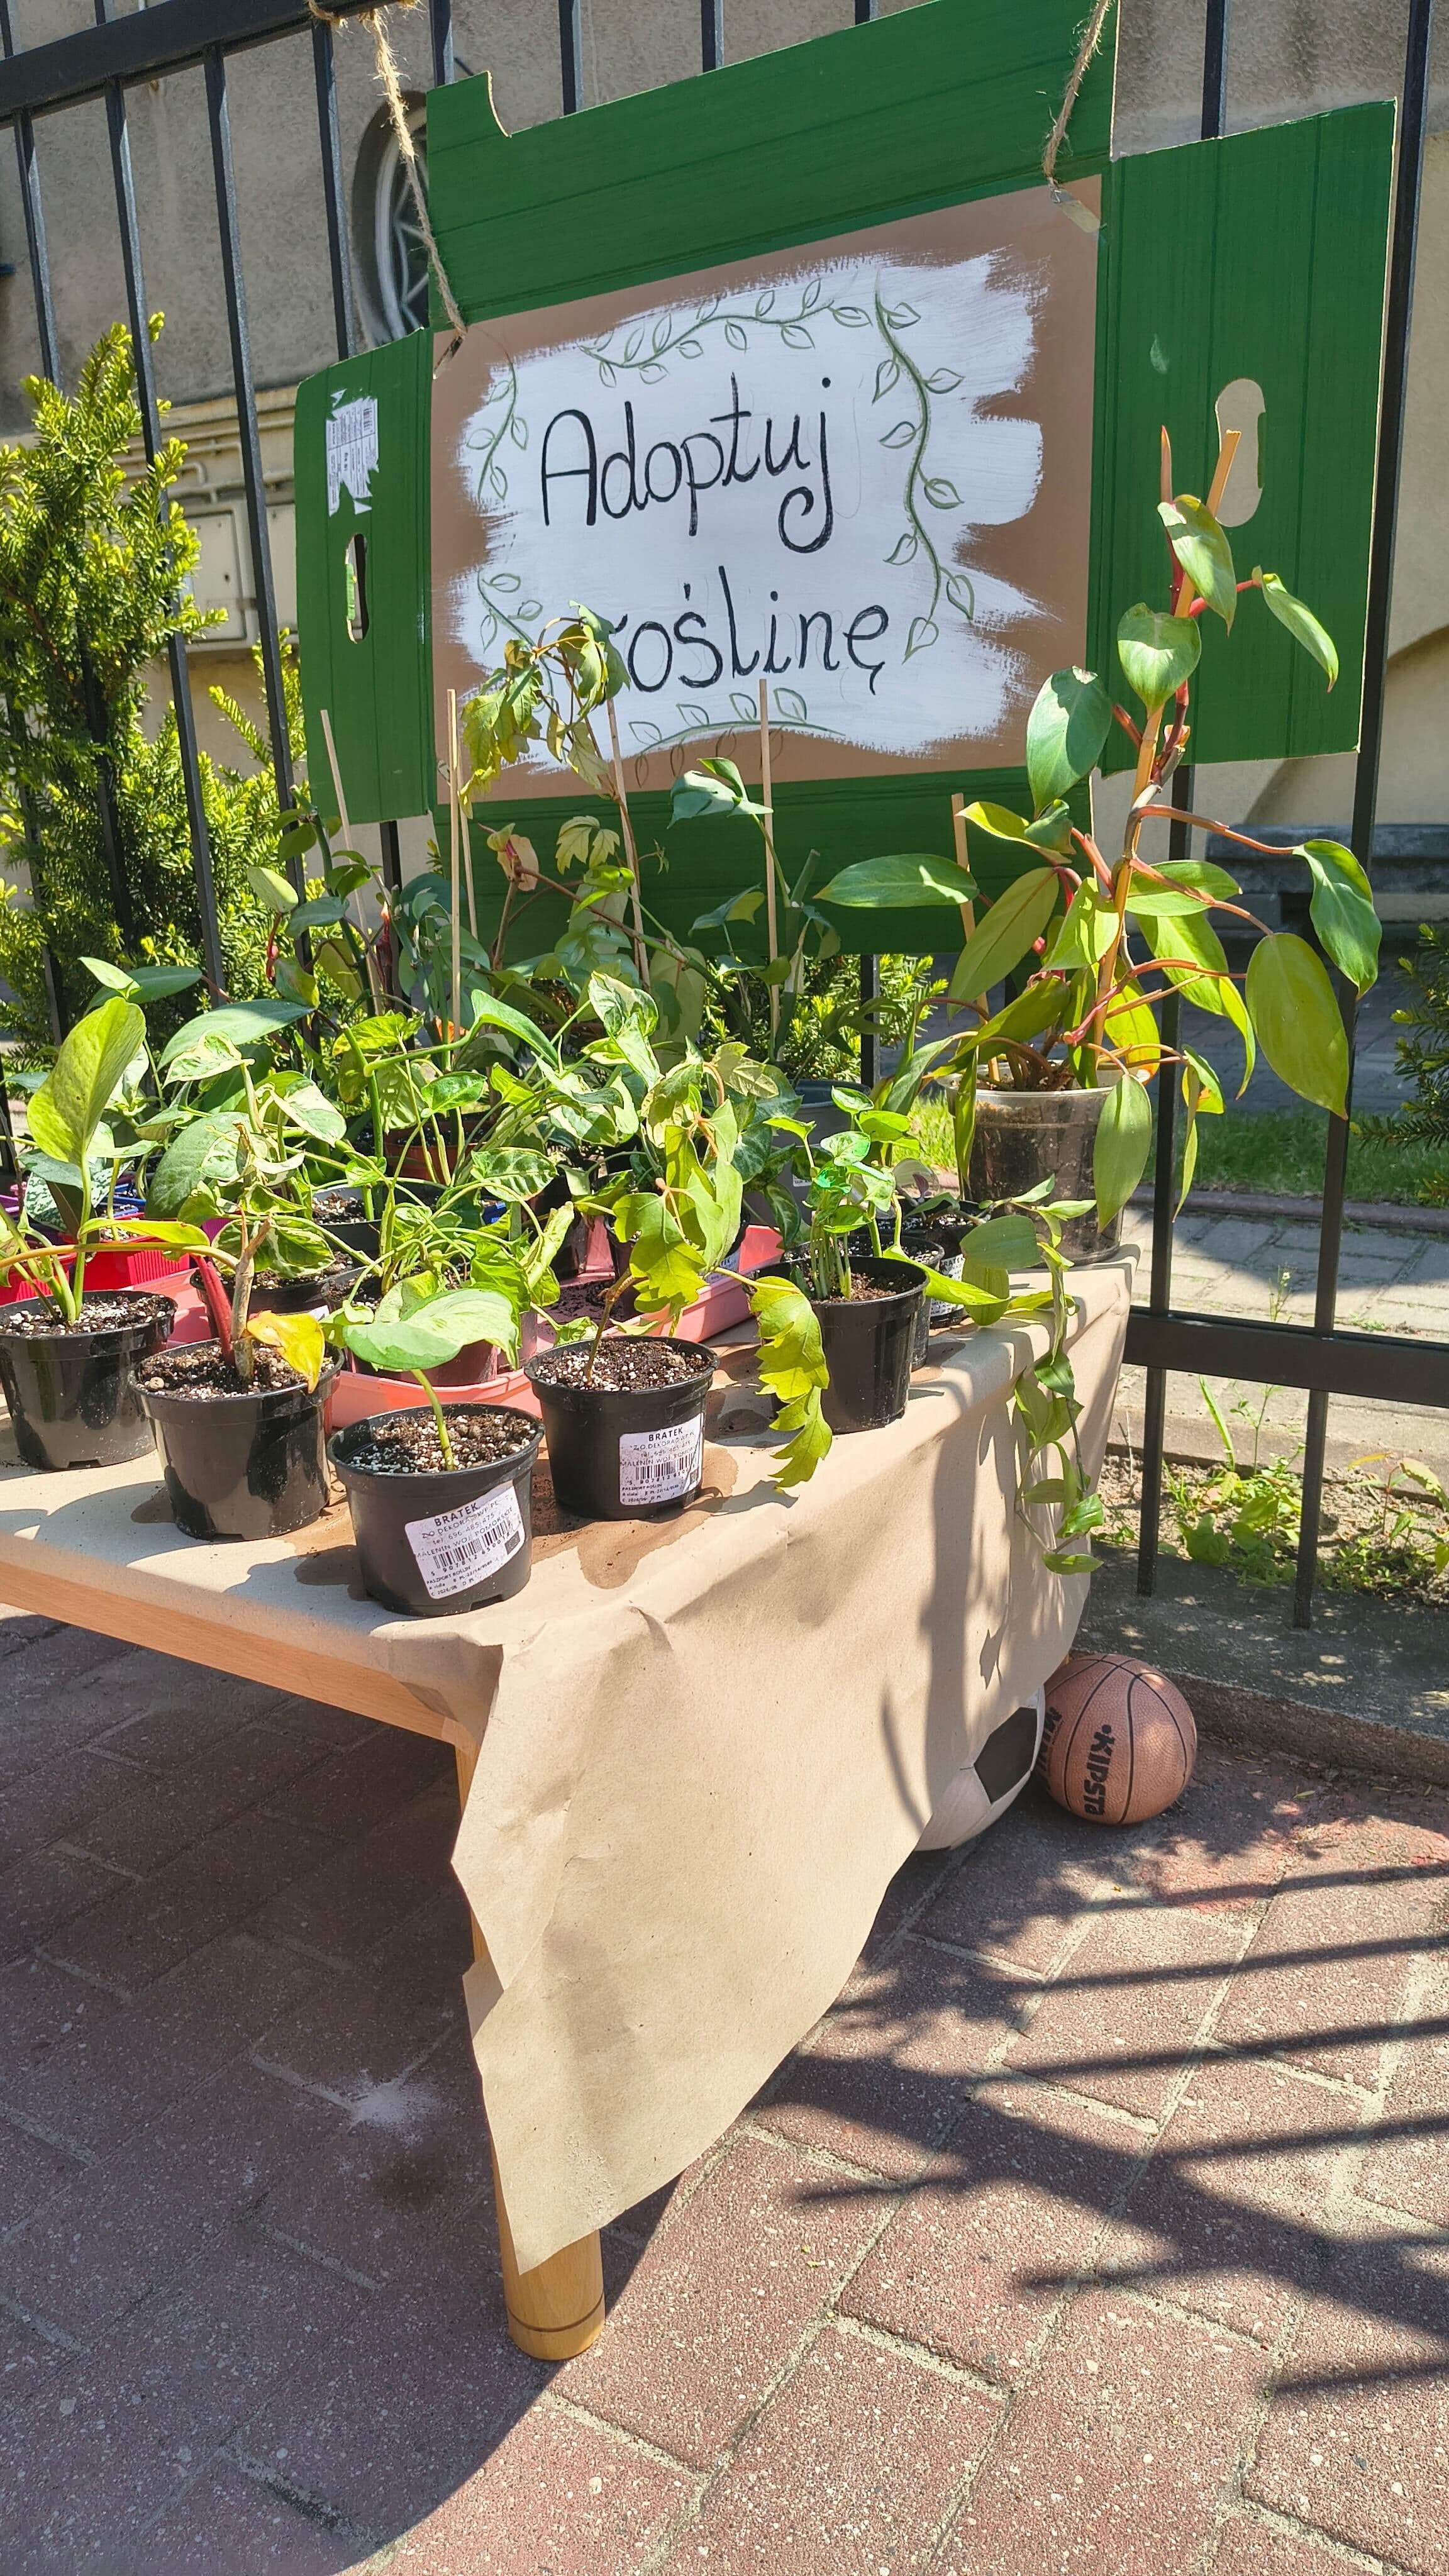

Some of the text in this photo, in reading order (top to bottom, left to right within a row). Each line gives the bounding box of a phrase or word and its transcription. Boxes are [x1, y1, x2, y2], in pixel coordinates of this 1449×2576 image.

[540, 372, 833, 553] Adoptuj
[609, 565, 890, 695] oślinę
[648, 1427, 683, 1441] BRATEK
[434, 1502, 480, 1527] BRATEK
